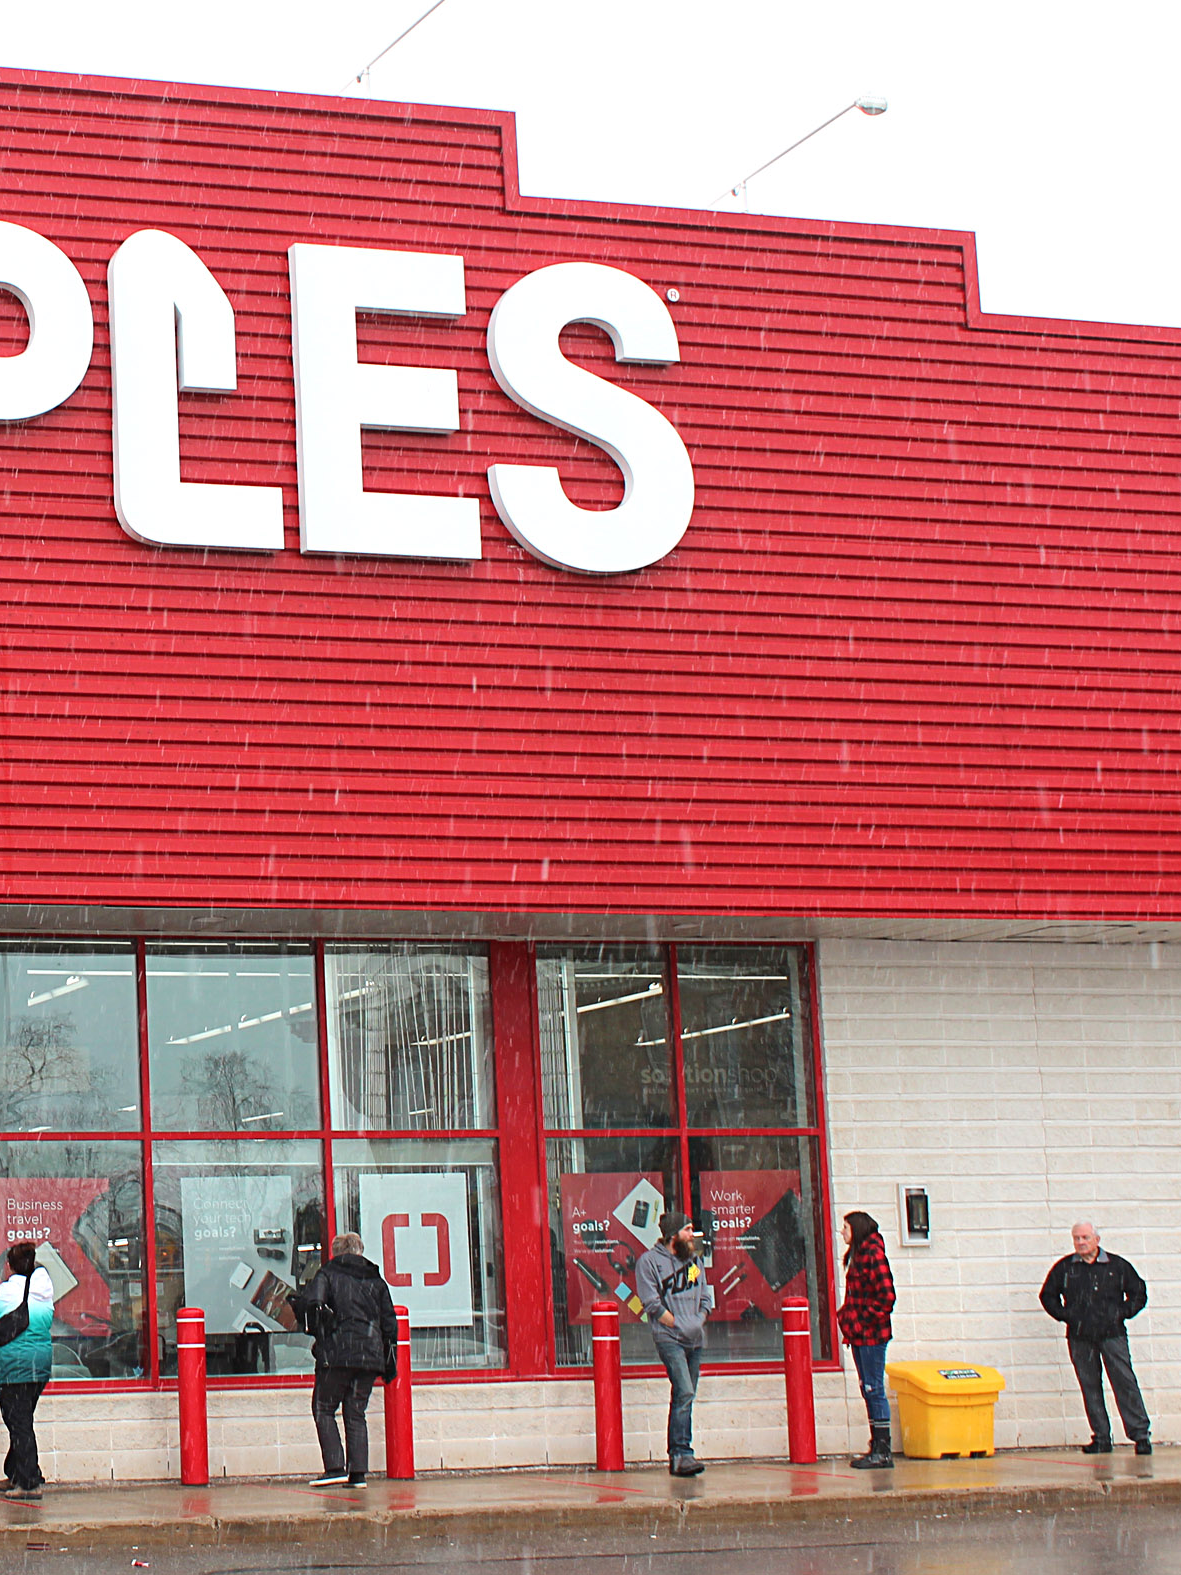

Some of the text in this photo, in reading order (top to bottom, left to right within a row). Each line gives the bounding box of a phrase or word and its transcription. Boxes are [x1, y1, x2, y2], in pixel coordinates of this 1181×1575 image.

[710, 1190, 743, 1201] Work
[7, 1198, 63, 1210] Business
[711, 1205, 755, 1215] smarter
[572, 1206, 587, 1218] A+
[7, 1213, 43, 1225] travel
[712, 1216, 752, 1231] goals?
[572, 1219, 611, 1235] goals?
[7, 1227, 51, 1242] goals?
[194, 1226, 236, 1241] goals?
